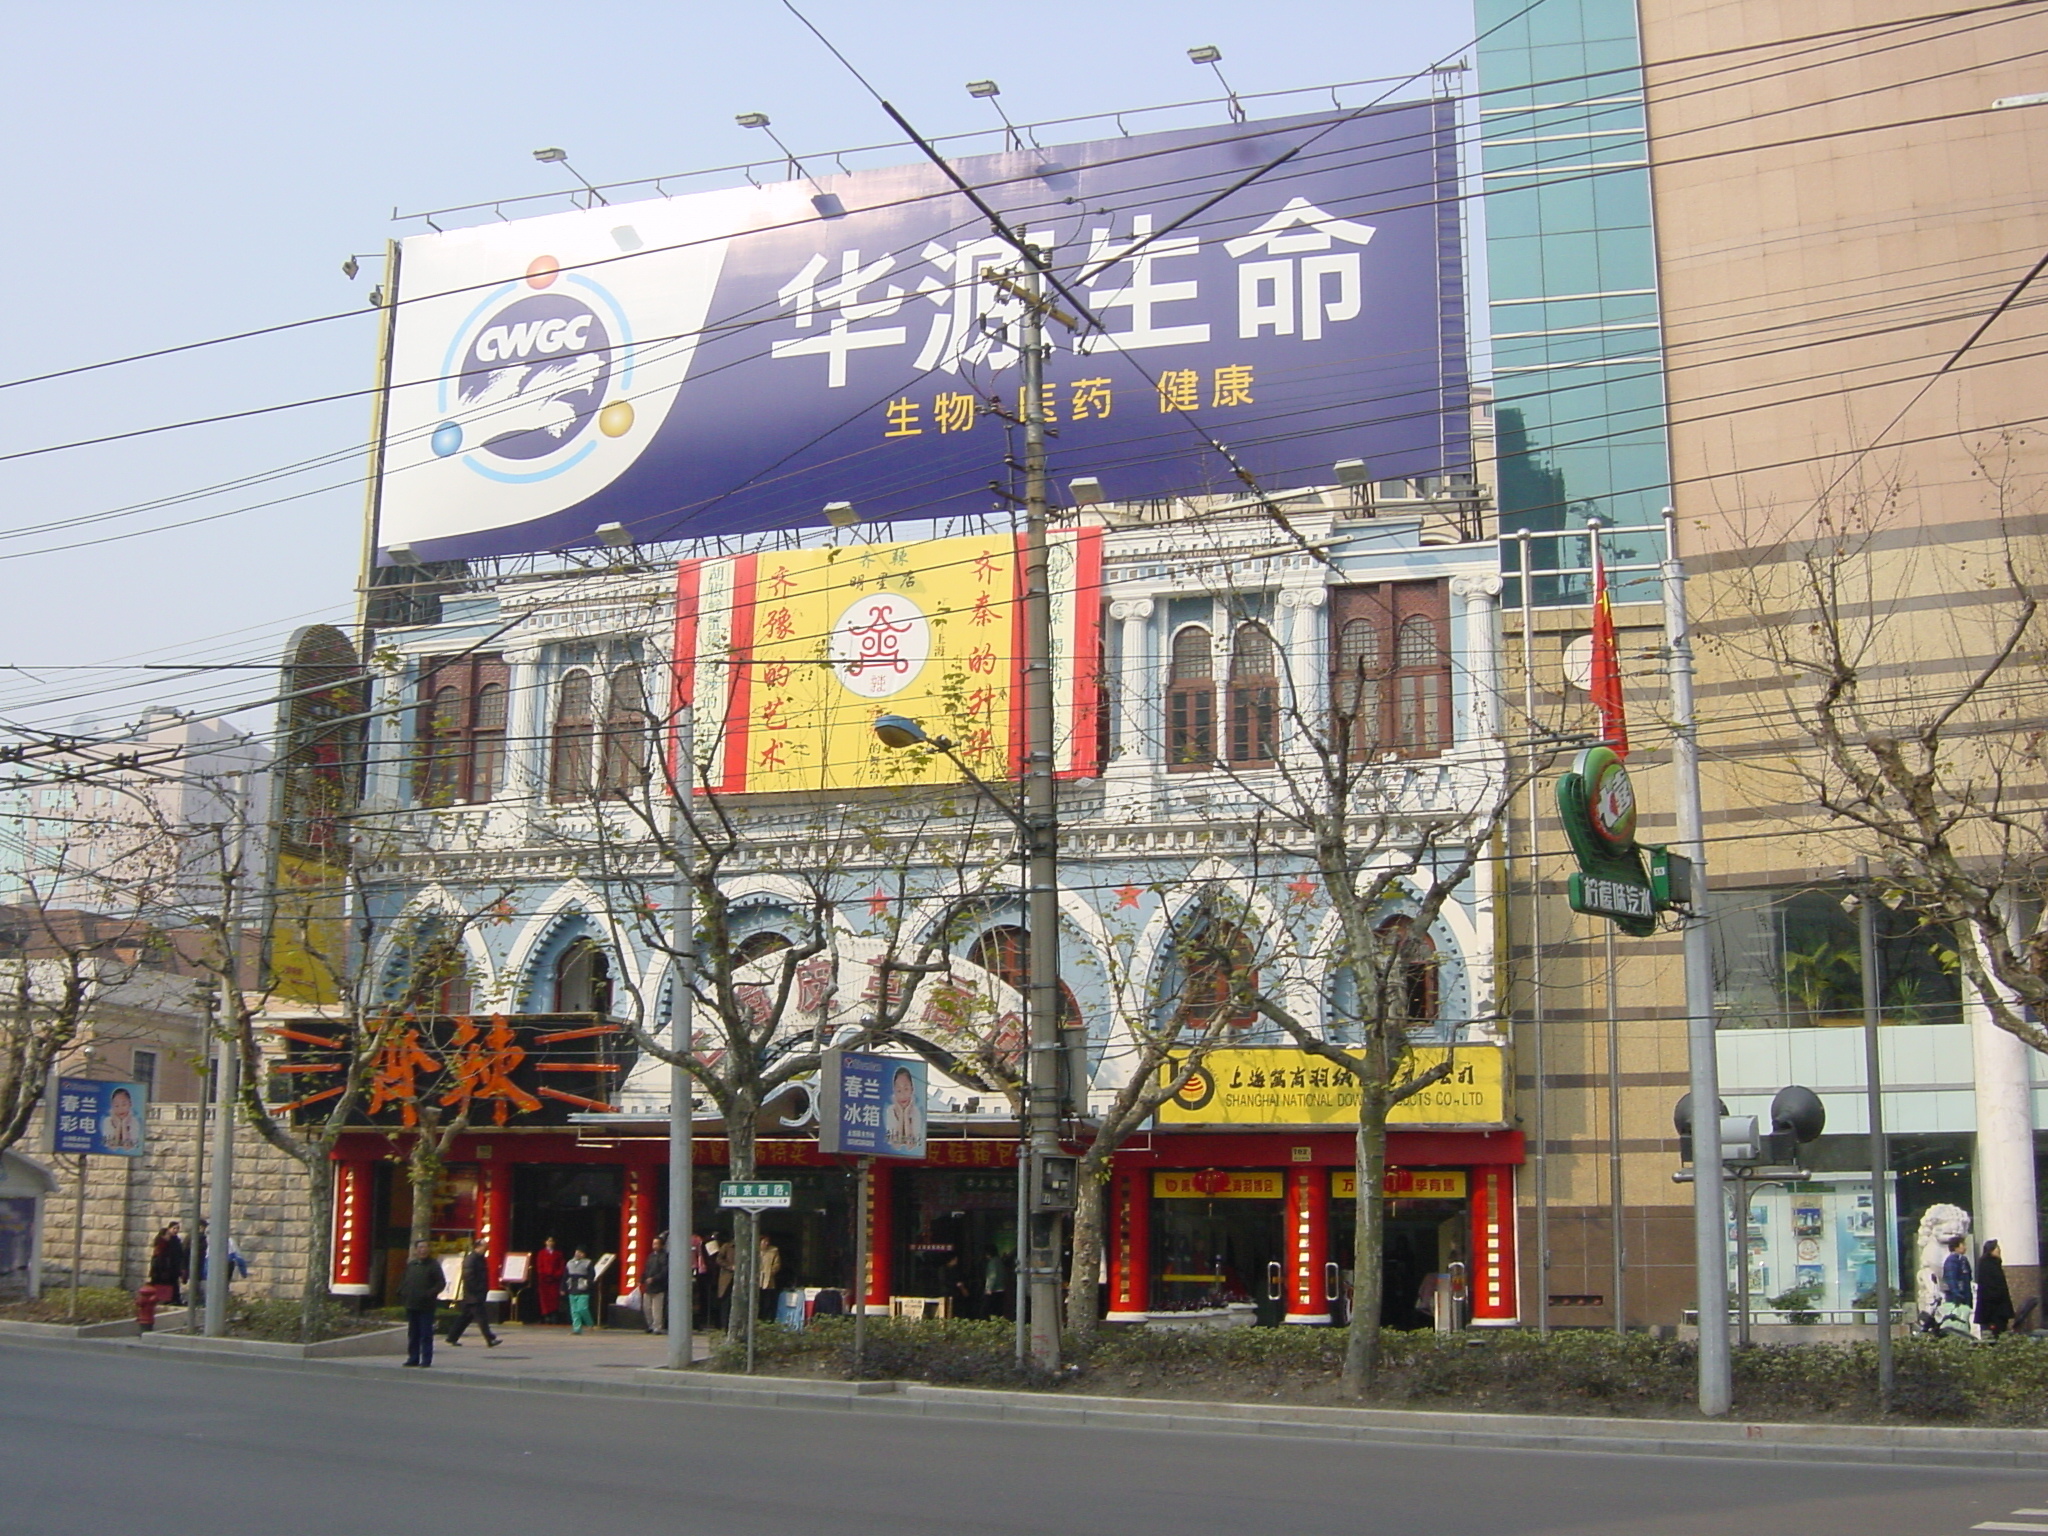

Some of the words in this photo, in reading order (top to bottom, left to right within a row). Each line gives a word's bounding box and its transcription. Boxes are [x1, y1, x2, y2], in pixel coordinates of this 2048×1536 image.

[771, 197, 1377, 388] 华源生命
[475, 314, 594, 362] CWGC
[884, 393, 976, 437] 生物
[1156, 365, 1255, 415] 健康
[760, 565, 798, 772] 齐豫的艺术
[845, 1075, 880, 1100] 春兰
[61, 1094, 97, 1113] 春兰
[1226, 1093, 1279, 1107] SHANGHAI
[1283, 1093, 1333, 1107] NATIONAL
[1337, 1093, 1362, 1107] DOW
[59, 1115, 97, 1134] 彩电
[844, 1103, 880, 1127] 冰箱
[728, 1184, 784, 1196] 南京西路
